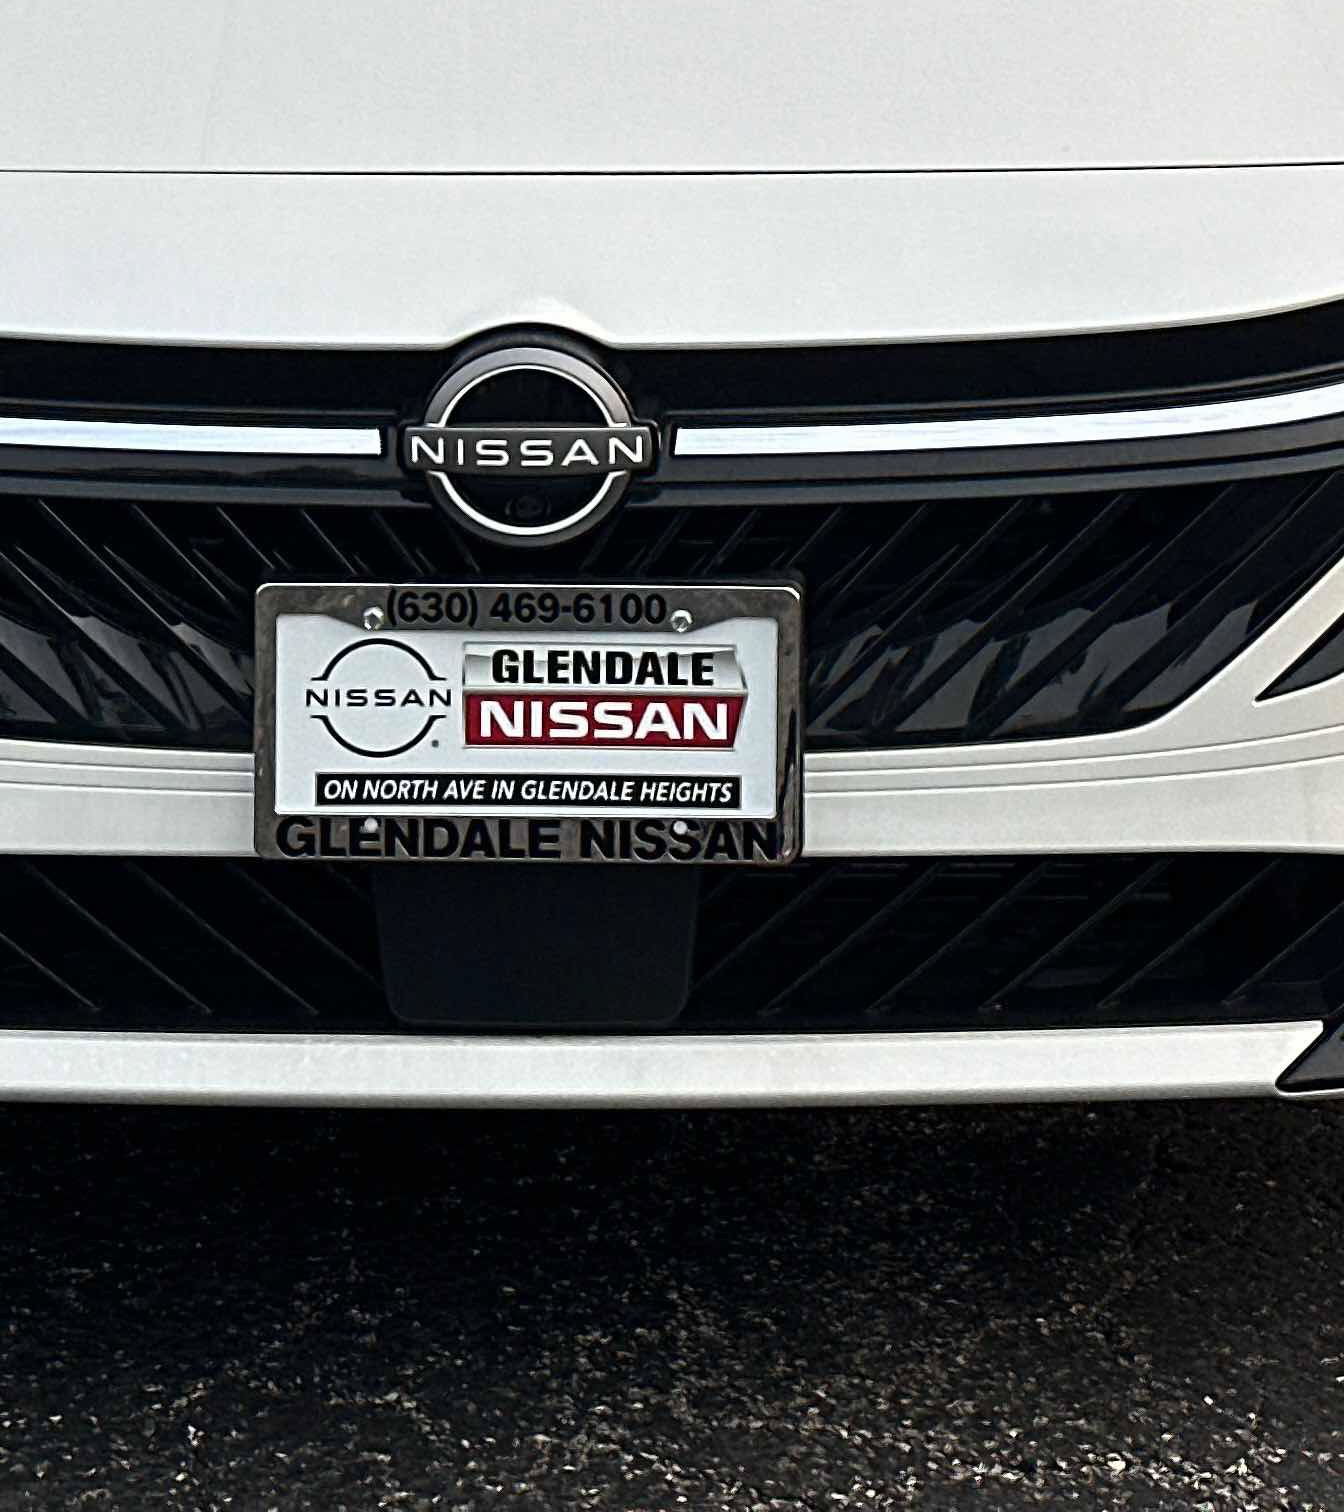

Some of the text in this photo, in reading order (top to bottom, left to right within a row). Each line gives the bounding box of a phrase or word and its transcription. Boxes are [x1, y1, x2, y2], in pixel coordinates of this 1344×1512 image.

[411, 435, 643, 467] NISSAN
[386, 590, 667, 627] (630) 469-6100
[492, 649, 714, 686] GLENDALE
[306, 688, 452, 707] NISSAN
[479, 700, 728, 740] NISSAN
[324, 778, 733, 803] ON NORTH AVE IN GLENDALE HEIGHTS
[275, 817, 778, 861] GLENDALE NISSAN
